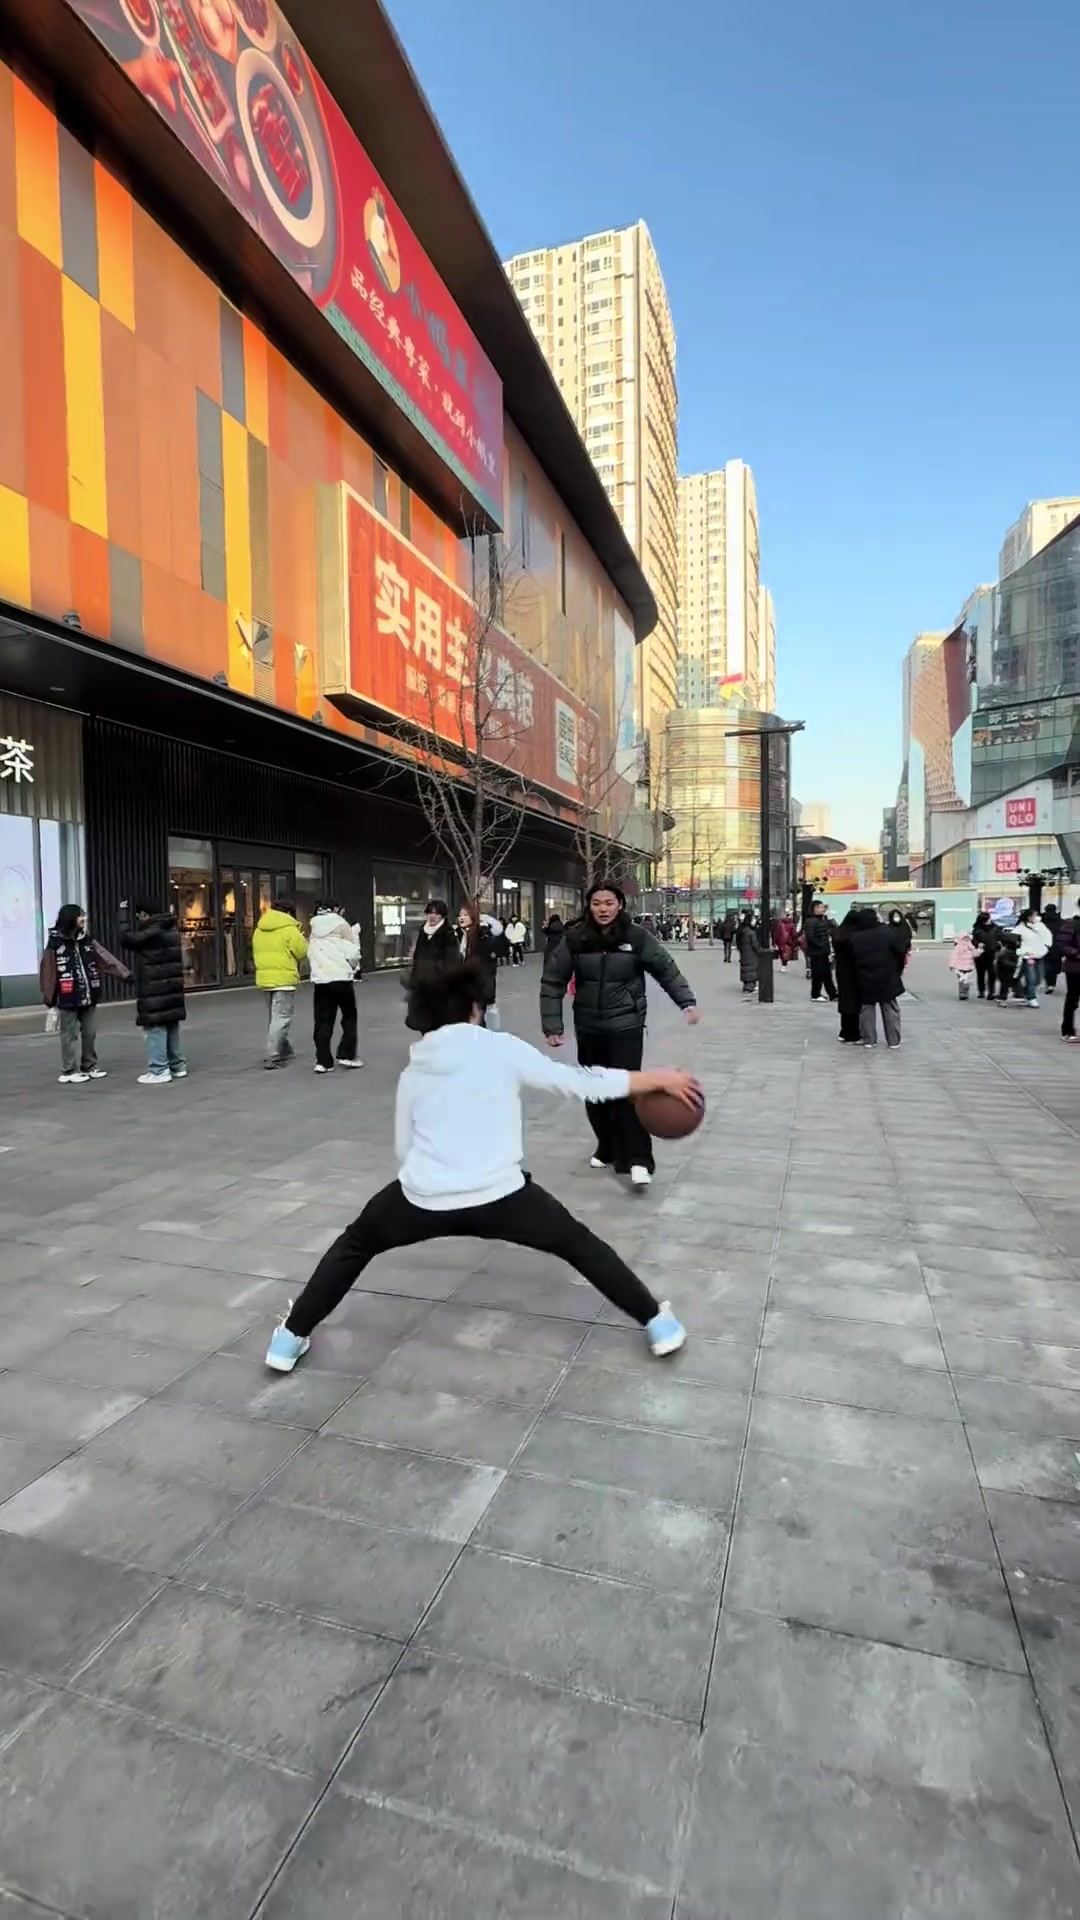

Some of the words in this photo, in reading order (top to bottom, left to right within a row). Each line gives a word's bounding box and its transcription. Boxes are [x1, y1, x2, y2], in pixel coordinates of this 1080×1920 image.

[0, 736, 34, 783] 茶
[1009, 801, 1032, 813] UNI
[1009, 813, 1034, 826] QLO
[997, 853, 1016, 862] UNI
[997, 863, 1017, 871] QLO
